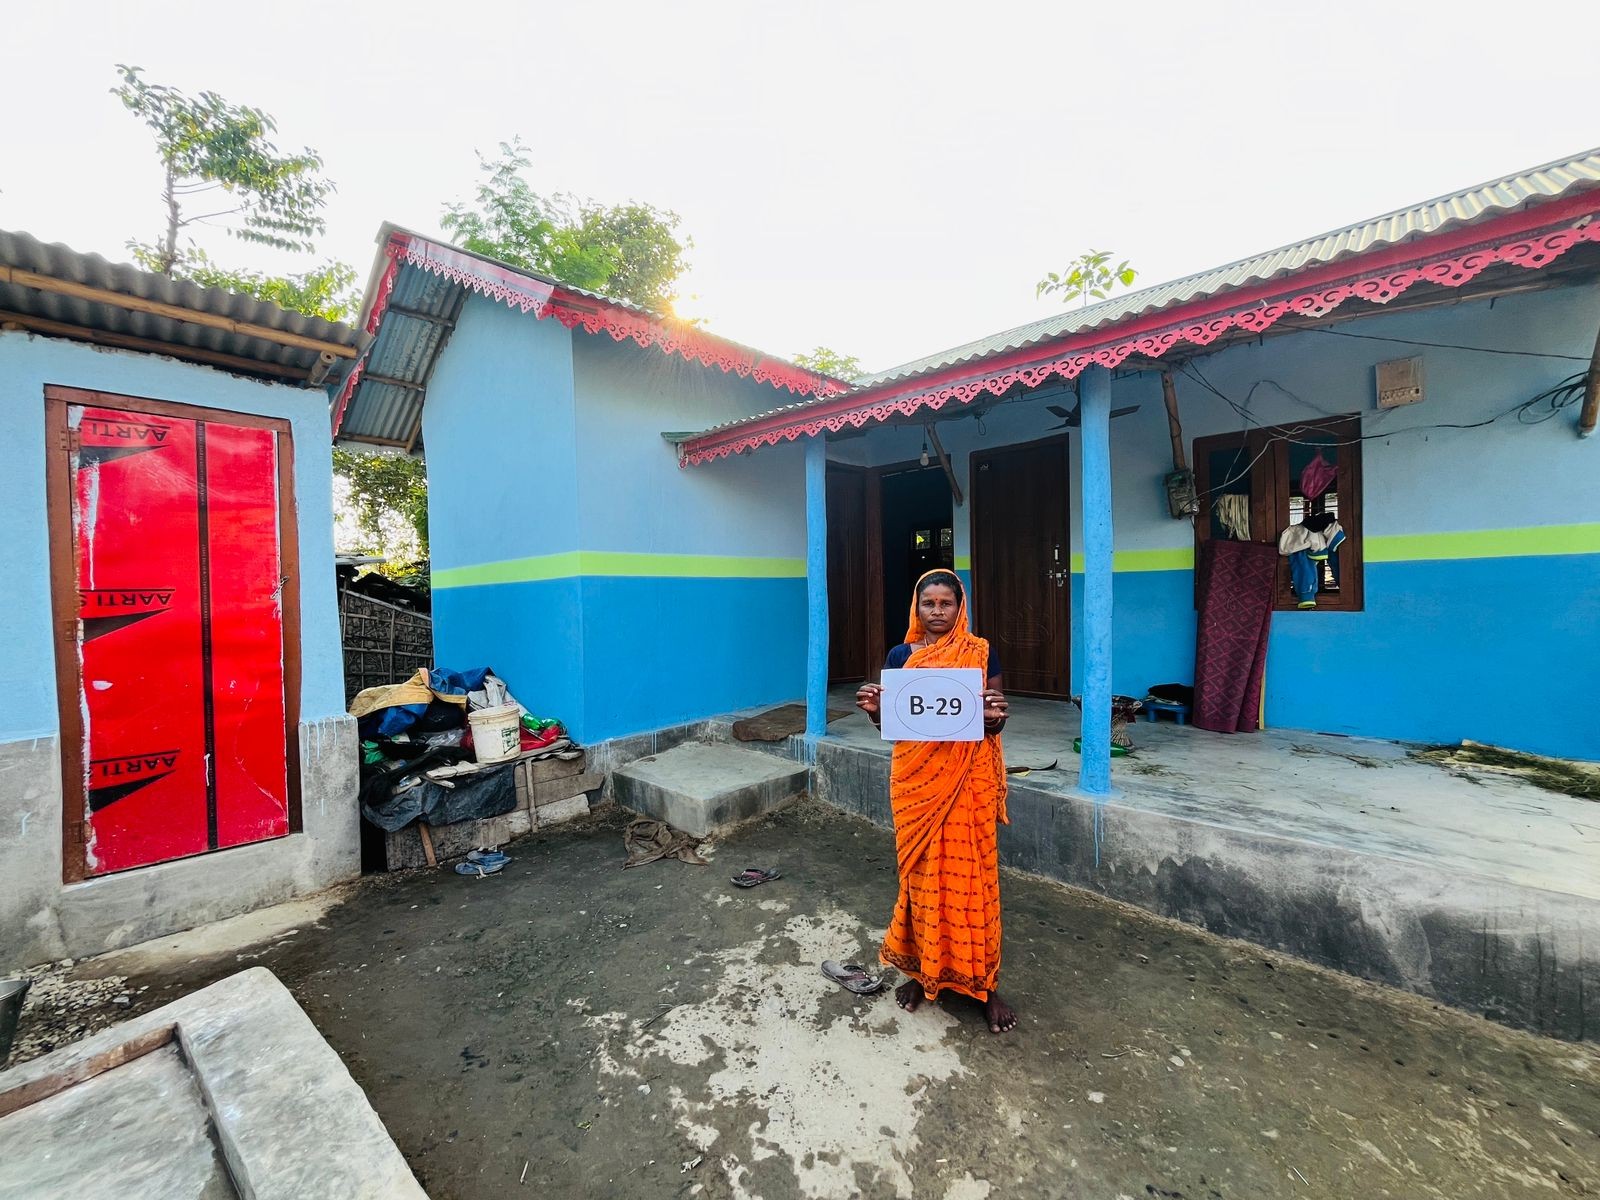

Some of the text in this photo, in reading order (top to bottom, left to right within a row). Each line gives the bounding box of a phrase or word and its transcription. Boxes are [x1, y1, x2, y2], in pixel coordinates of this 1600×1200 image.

[92, 423, 168, 441] AARTI
[97, 593, 172, 607] AARTI
[910, 695, 962, 716] B-29
[103, 756, 177, 777] AARTI
